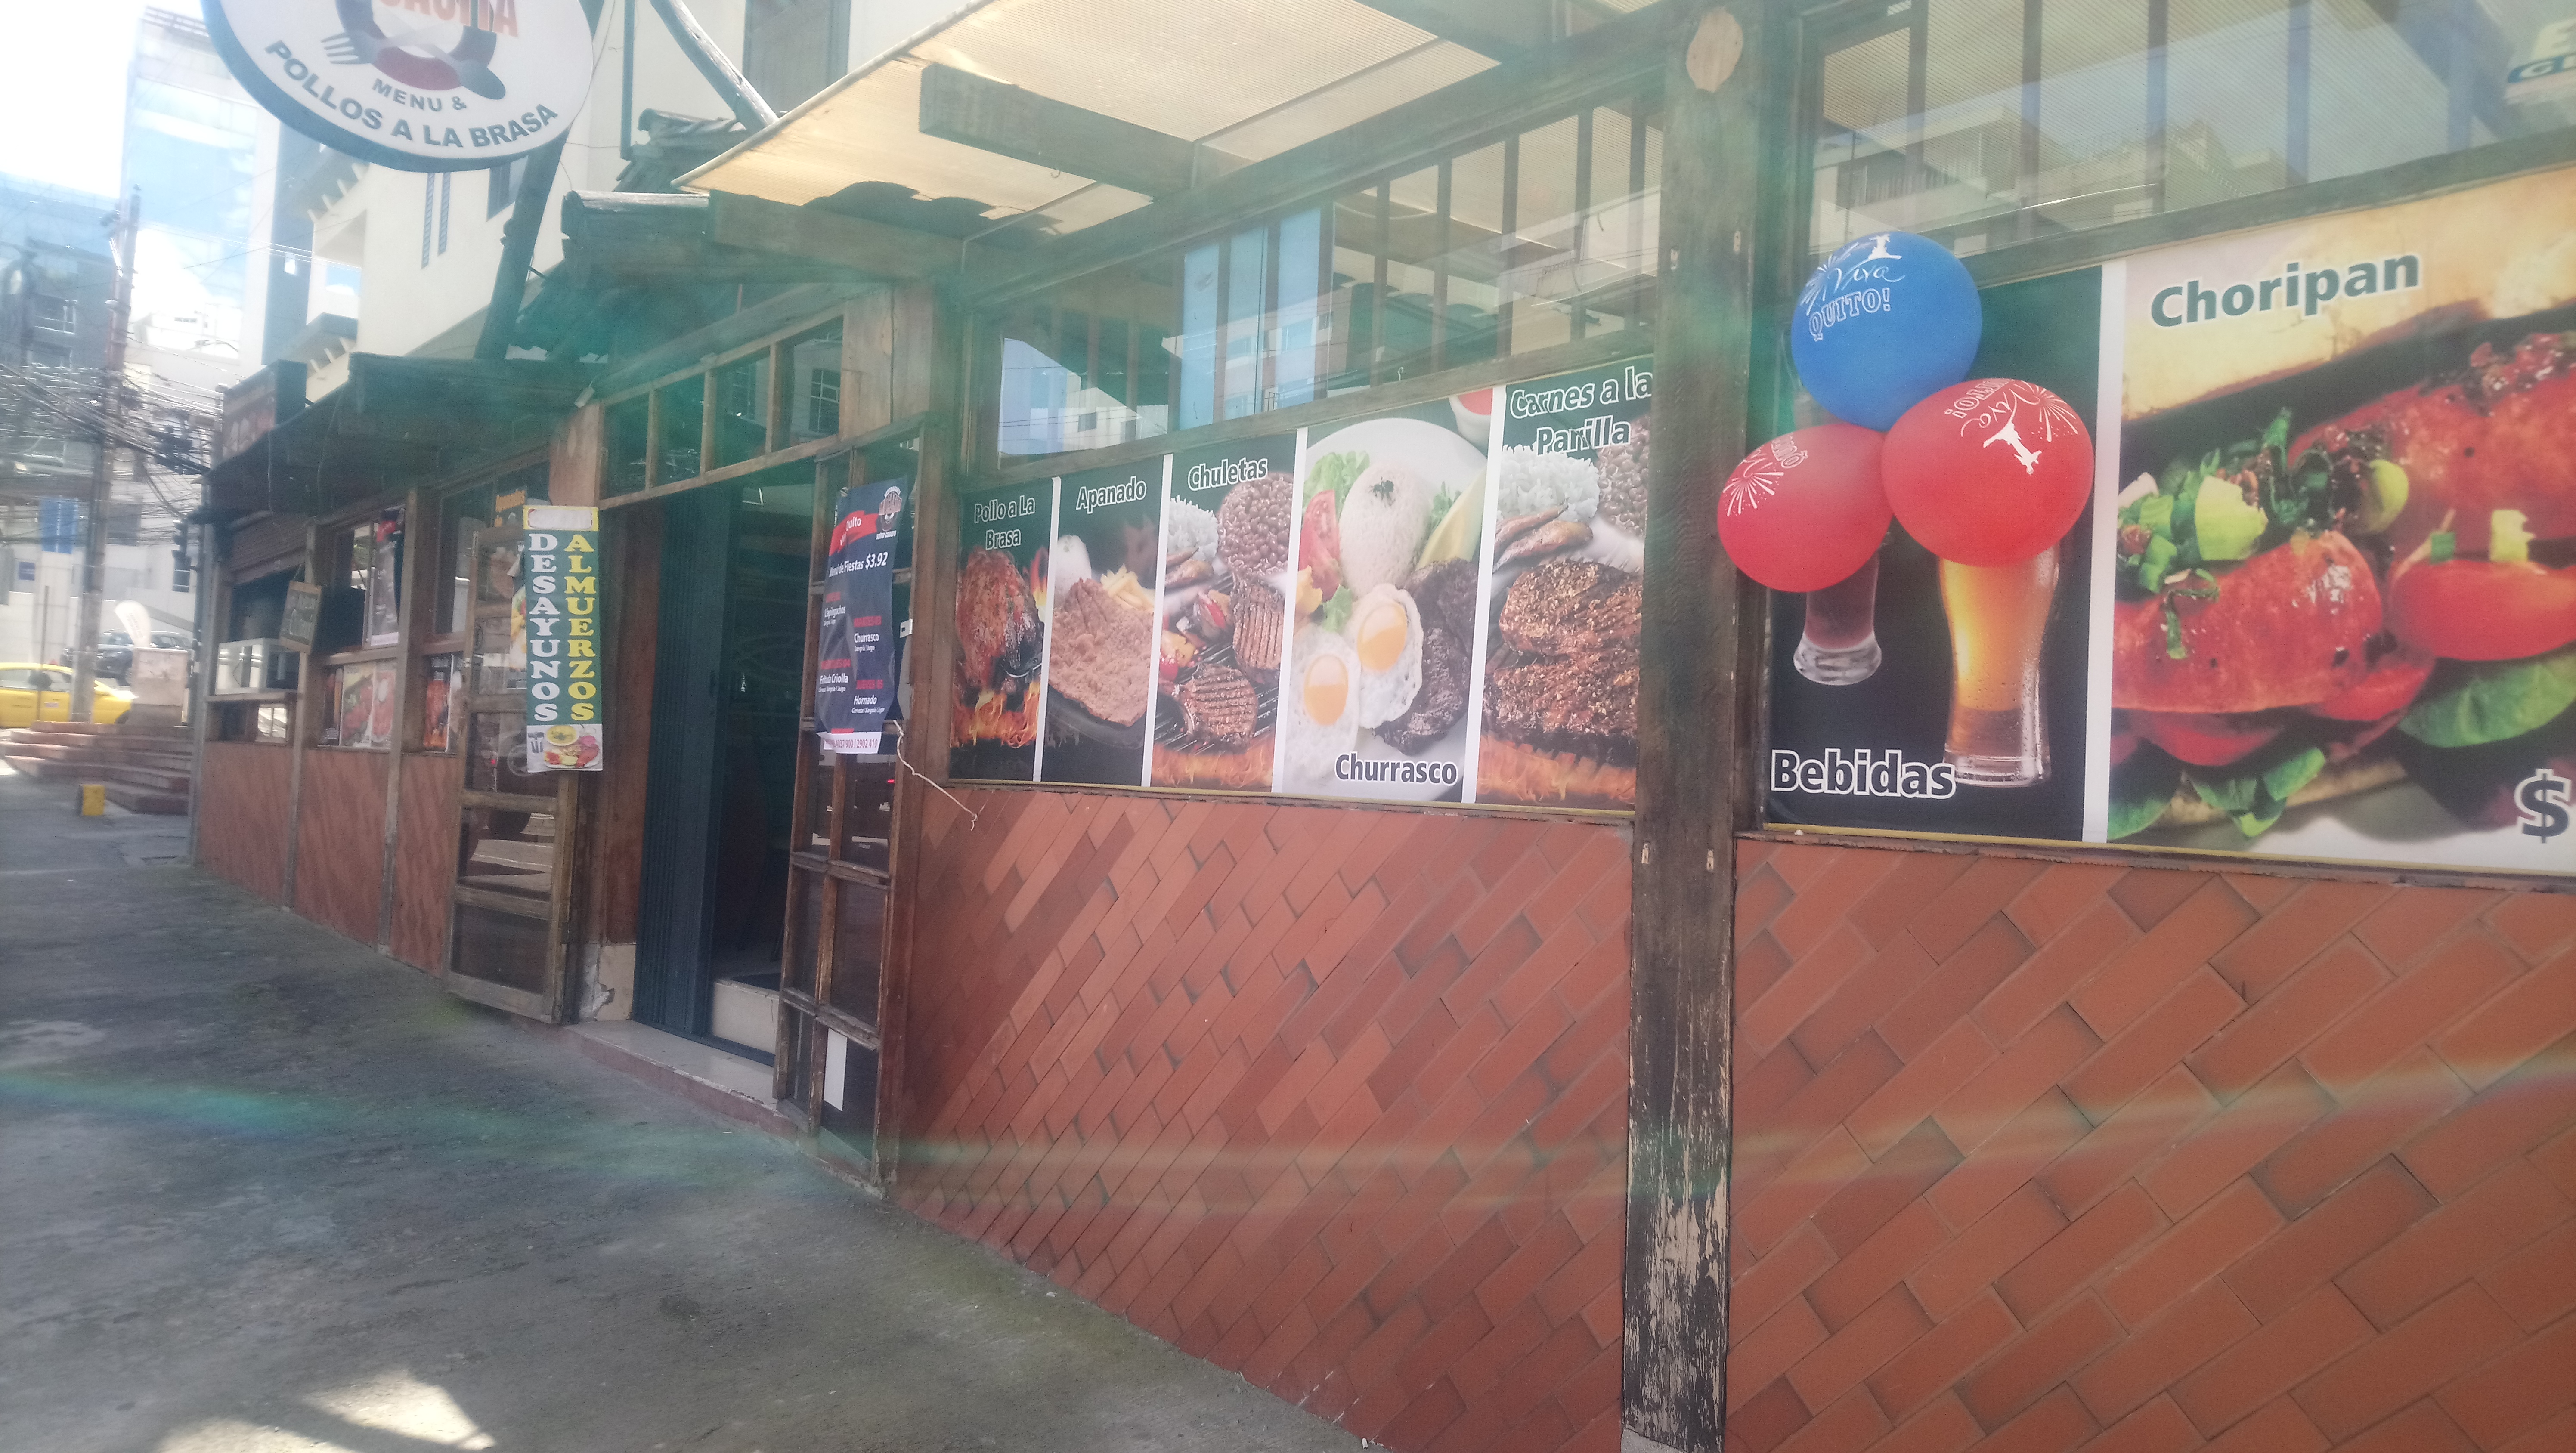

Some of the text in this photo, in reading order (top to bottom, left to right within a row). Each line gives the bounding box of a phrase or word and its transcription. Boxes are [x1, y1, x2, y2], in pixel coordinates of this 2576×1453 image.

[264, 40, 558, 148] POLLOS A LA BRASA
[372, 78, 466, 112] MENU &
[1827, 263, 1906, 294] Viva
[2151, 253, 2421, 328] Choripan
[1809, 287, 1891, 342] QUITO!
[1510, 365, 1653, 419] Carnes a la
[1188, 457, 1268, 492] Chuletas
[974, 495, 1035, 524] Pollo a La
[1076, 476, 1147, 514] Apanado
[986, 529, 1021, 551] Brasa
[844, 560, 864, 573] Fiestas
[865, 551, 888, 571] $3.92
[529, 533, 560, 722] DESAYUNOS
[564, 533, 597, 721] ALMUERZOS
[854, 632, 879, 643] Churrasco
[831, 673, 849, 683] Criolla
[853, 694, 877, 705] Hornado
[857, 739, 868, 748] 2902
[868, 739, 878, 748] 410
[1334, 751, 1459, 786] Churrasco
[1771, 748, 1957, 799] Bebidas
[2514, 768, 2572, 844] $
